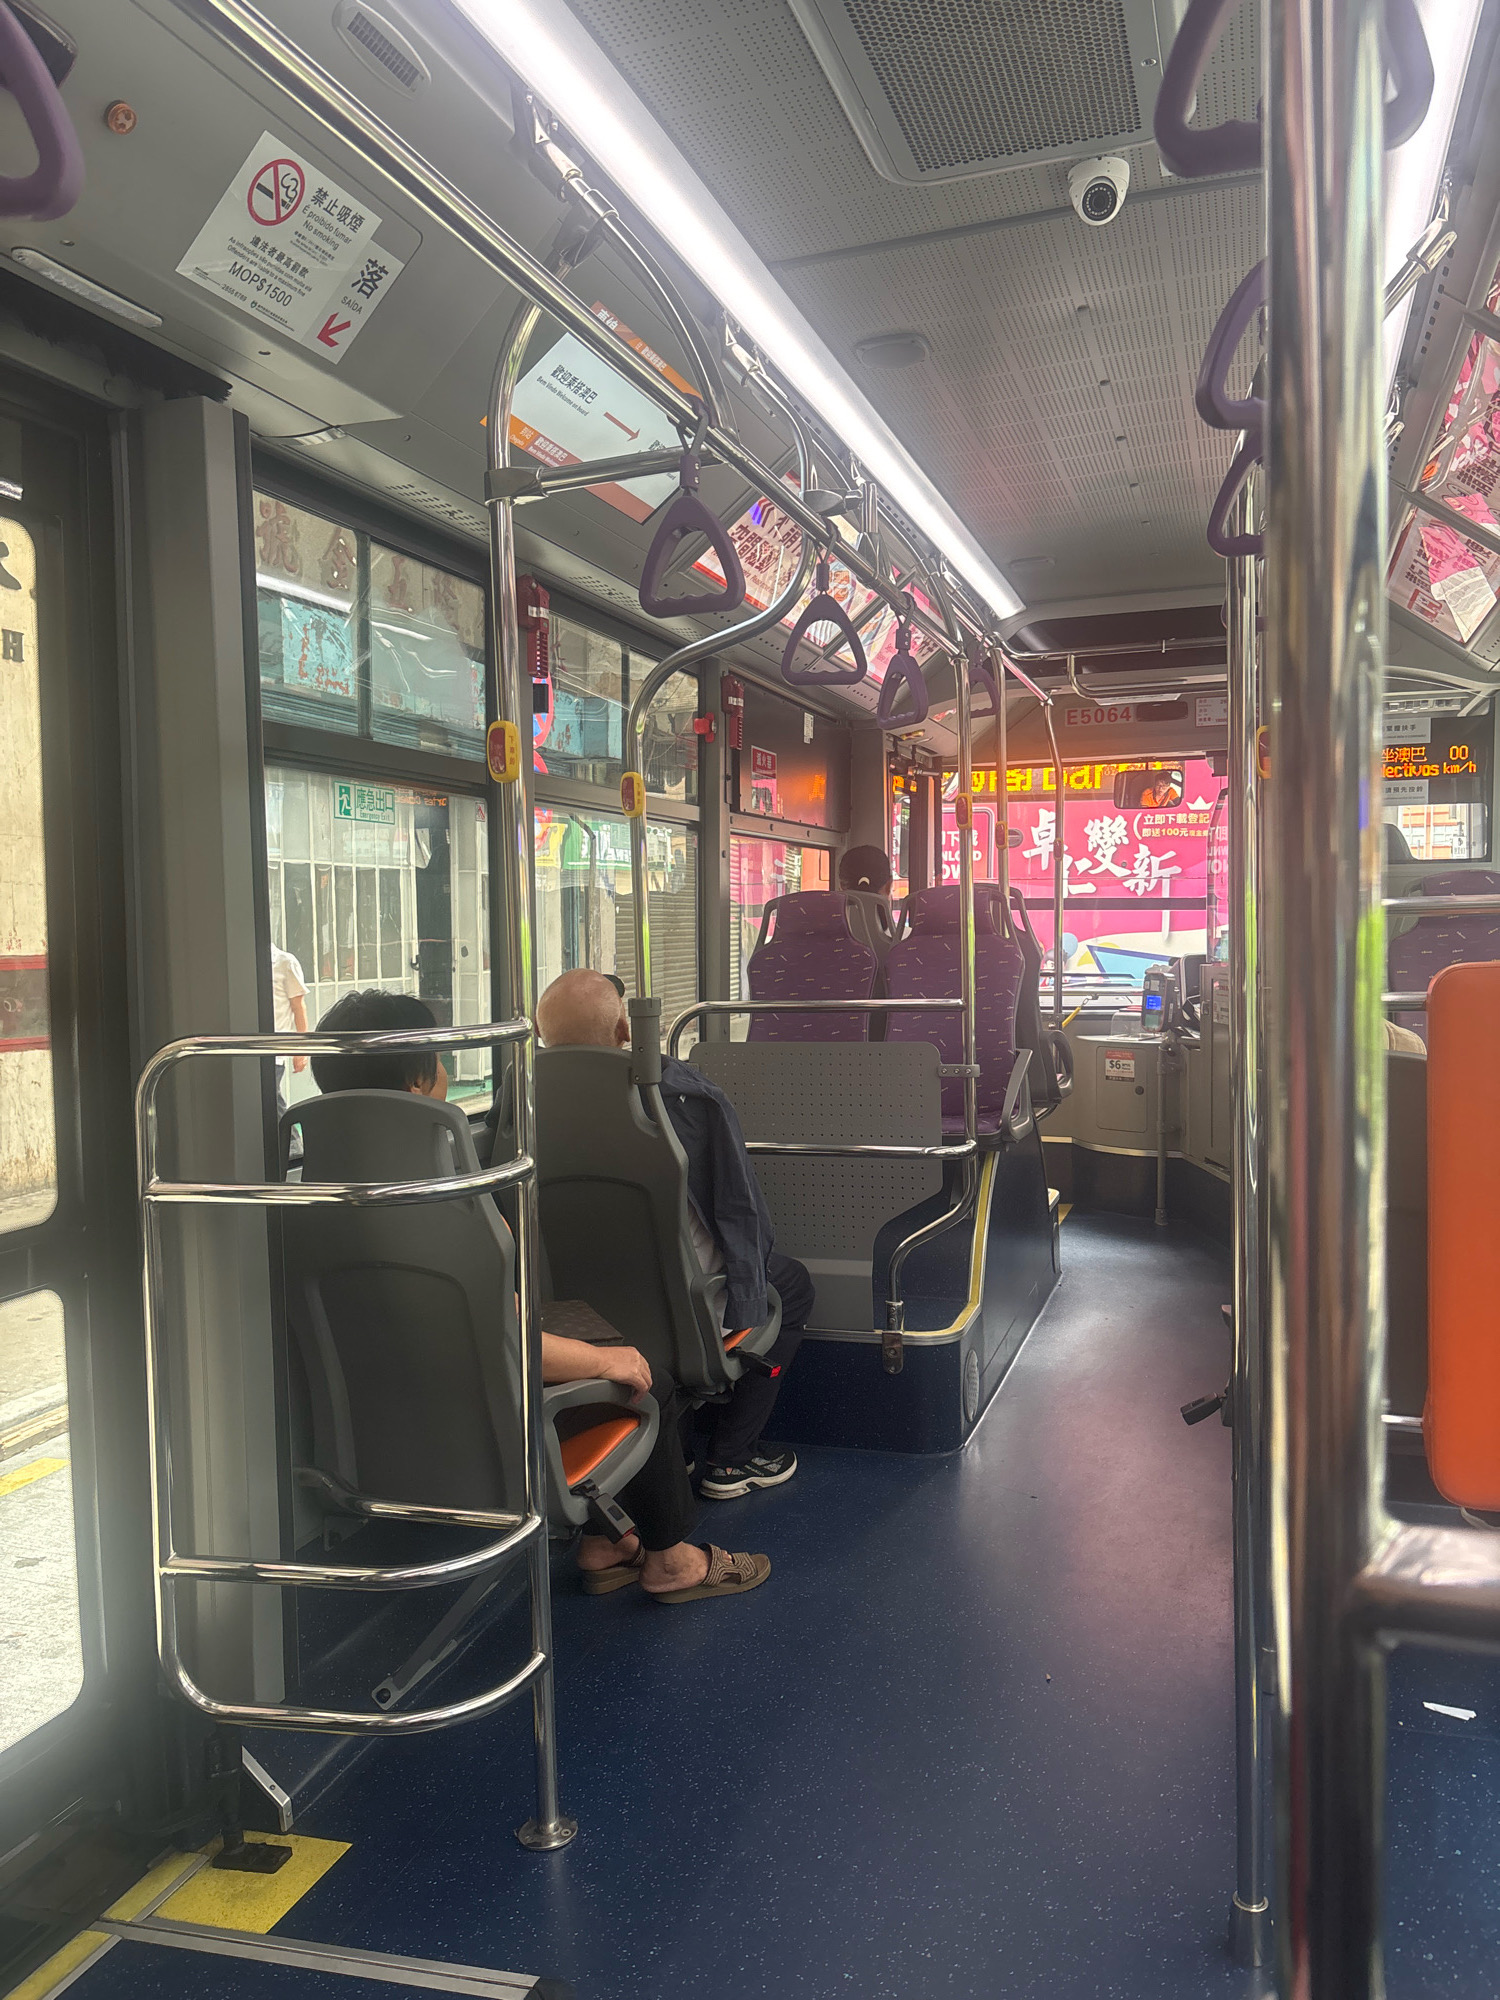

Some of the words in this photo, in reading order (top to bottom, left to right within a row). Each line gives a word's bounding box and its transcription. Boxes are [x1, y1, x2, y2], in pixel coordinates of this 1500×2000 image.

[311, 187, 365, 233] 禁止吸煙
[302, 204, 311, 214] É
[307, 211, 334, 232] proibido
[333, 227, 352, 244] fumar
[303, 220, 314, 231] No
[313, 228, 340, 251] smoking
[228, 261, 292, 307] MOP$1500
[351, 258, 389, 299] 落
[341, 296, 363, 314] SAÍDA
[1067, 706, 1132, 725] E5064
[1449, 745, 1469, 760] 00
[1443, 761, 1477, 774] km/h
[356, 788, 395, 812] 應急出口
[1143, 813, 1210, 825] 立即下載登記
